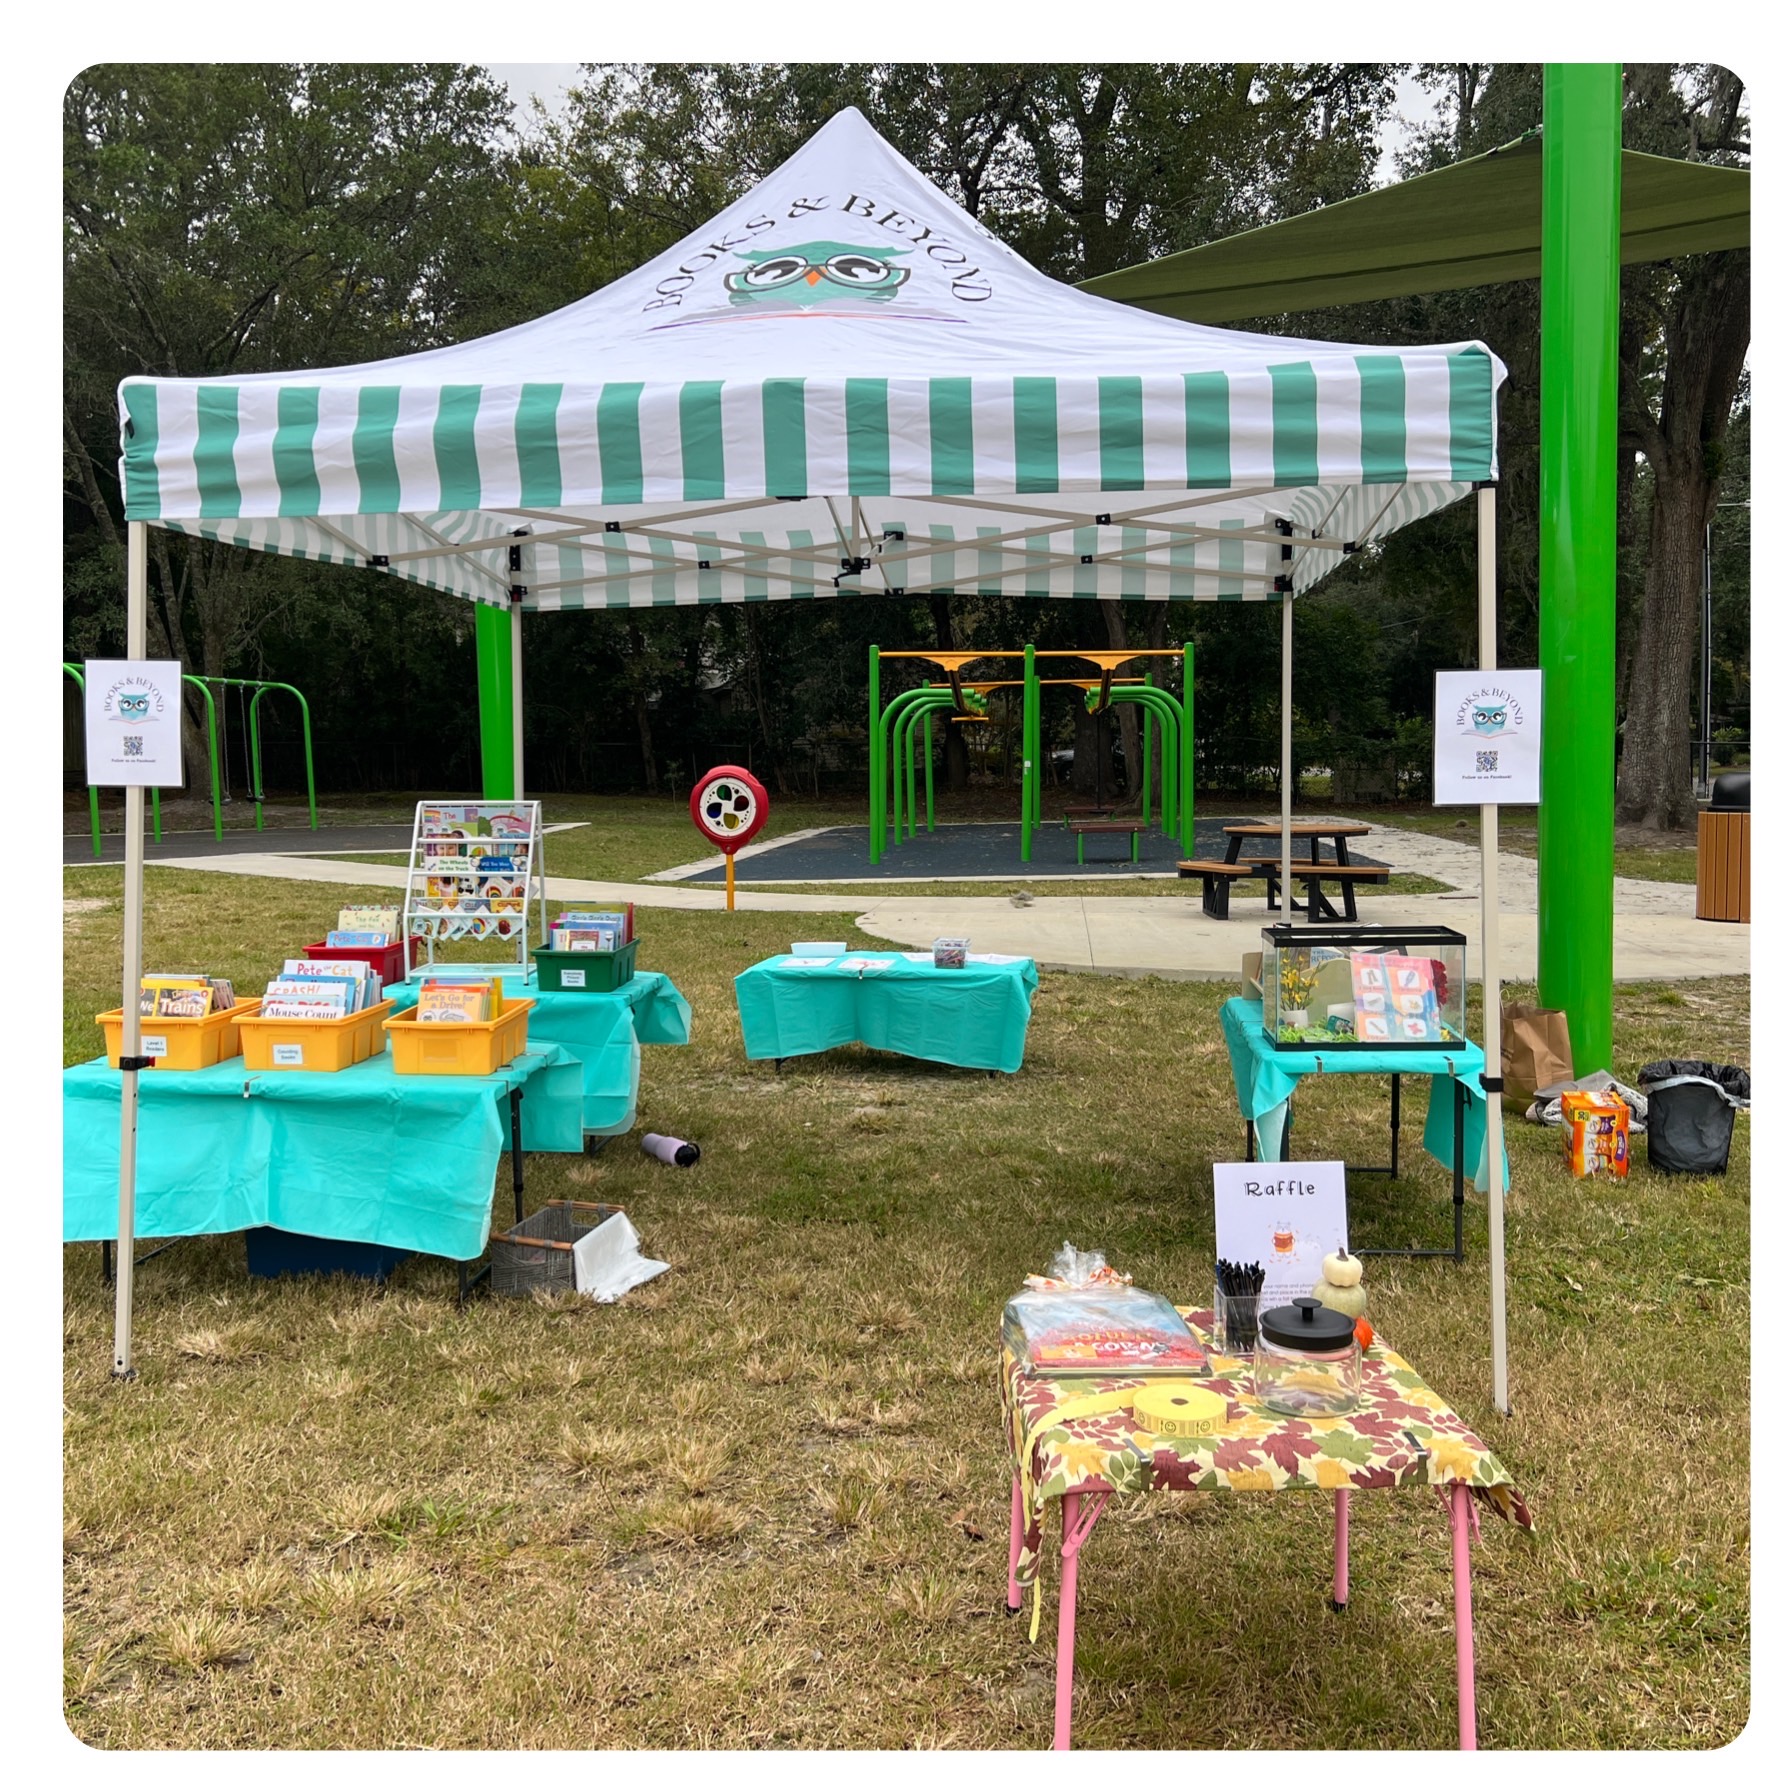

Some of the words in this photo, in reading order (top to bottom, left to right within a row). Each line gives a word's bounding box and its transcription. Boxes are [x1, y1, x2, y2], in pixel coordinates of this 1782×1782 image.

[642, 213, 776, 312] BOOKS
[787, 194, 831, 219] &
[838, 193, 993, 303] BEYOND
[104, 679, 126, 712] BOOKS
[136, 676, 165, 713] BEYOND
[1456, 691, 1480, 726] BOOKS
[1491, 687, 1524, 725] BEYOND
[297, 963, 322, 976] Pete
[332, 964, 353, 976] Cat
[160, 998, 204, 1014] Trains
[269, 1008, 303, 1017] Mouse
[304, 1009, 338, 1020] Count
[1245, 1180, 1315, 1197] Raffle
